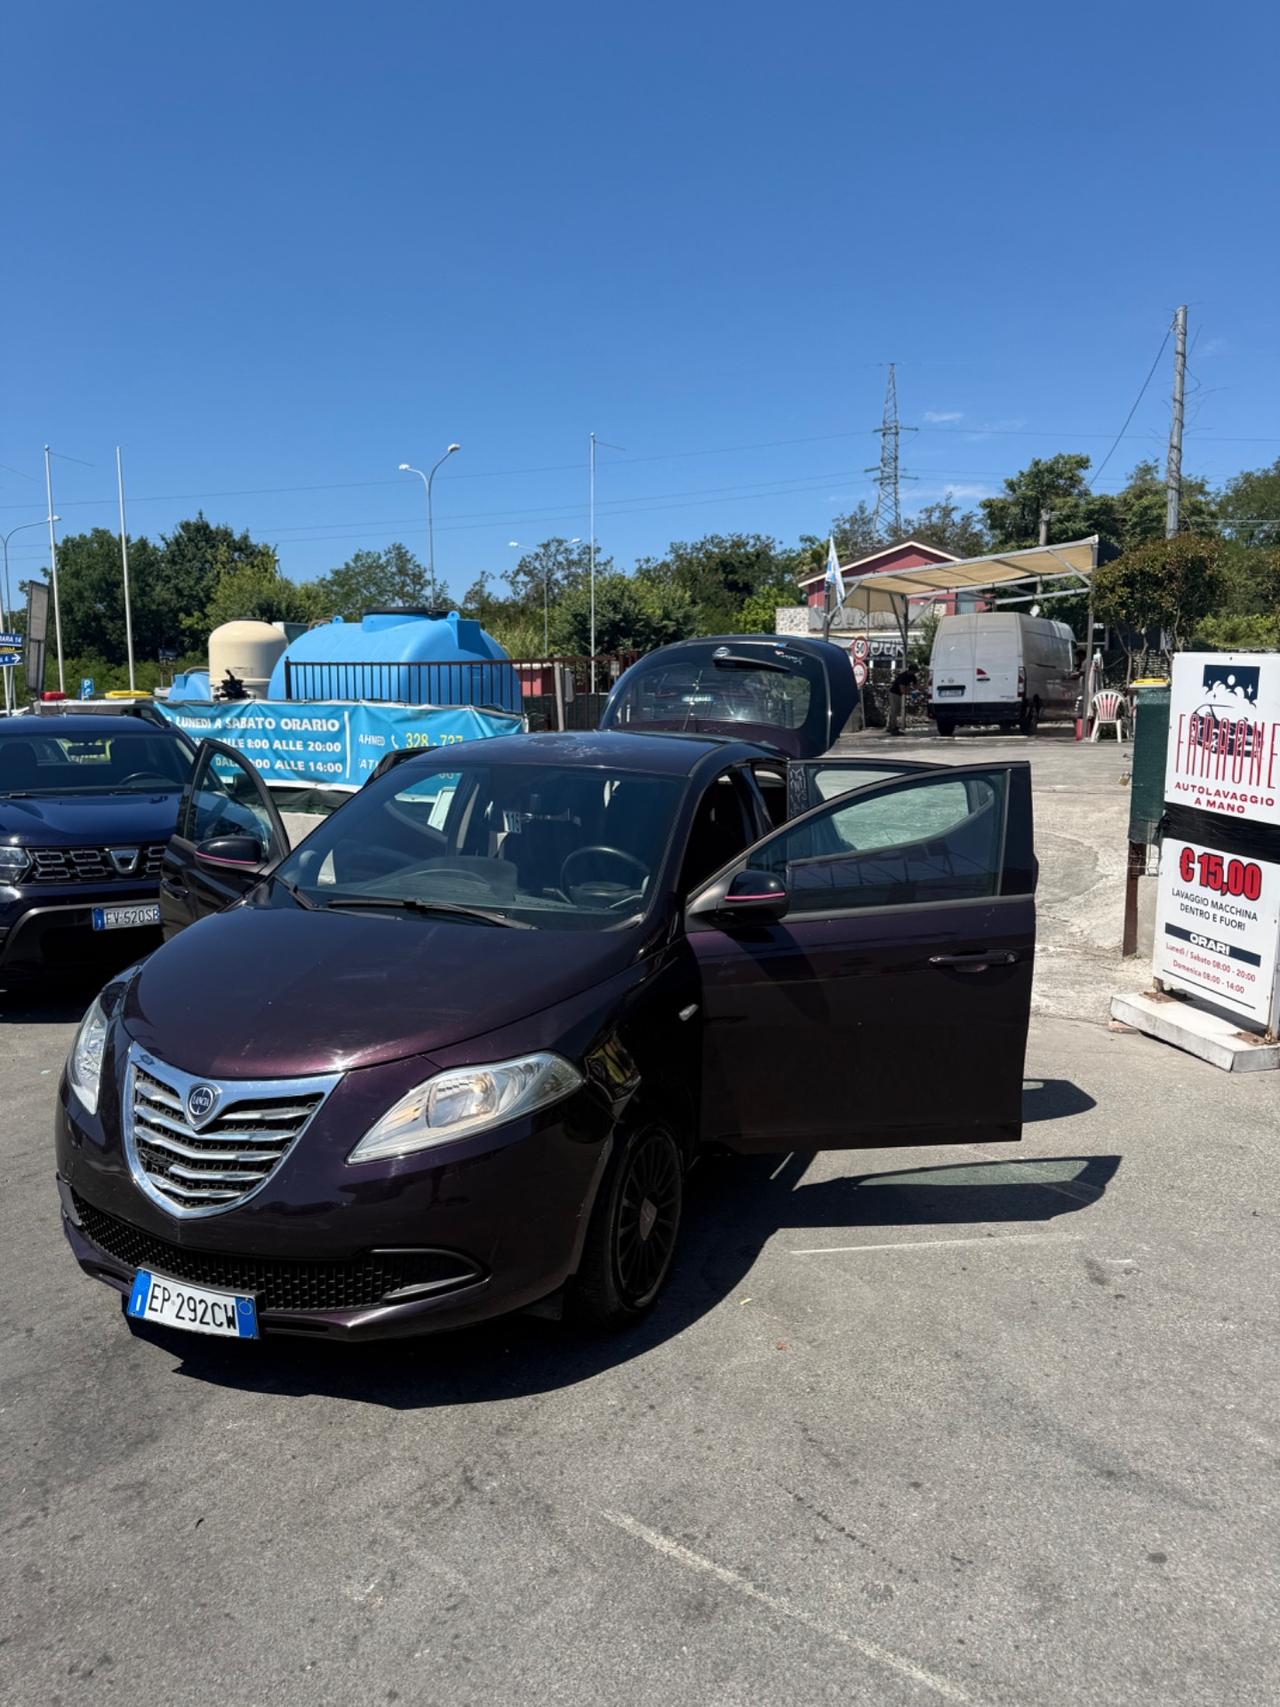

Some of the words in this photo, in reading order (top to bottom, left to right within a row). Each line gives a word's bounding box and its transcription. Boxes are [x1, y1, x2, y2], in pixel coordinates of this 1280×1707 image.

[213, 717, 222, 729] A
[225, 717, 276, 730] SABATO
[280, 718, 341, 732] ORARIO
[218, 738, 245, 749] ALLE
[272, 740, 303, 751] ALLE
[307, 741, 342, 753] 20:00
[405, 732, 429, 749] 328
[274, 762, 305, 772] ALLE
[309, 761, 343, 774] 14:00
[1174, 781, 1275, 807] AUTOLAVAGGIO
[1194, 797, 1202, 806] A
[1206, 799, 1246, 814] MANO
[1179, 846, 1196, 883] €
[1197, 851, 1263, 901] 15,00
[1171, 888, 1209, 908] LAVAGGIO
[1210, 900, 1258, 922] MACCHINA
[1179, 902, 1211, 921] DENTRO
[1212, 913, 1218, 923] E
[1219, 915, 1246, 931] FUORI
[1189, 933, 1231, 956] ORARI
[1173, 959, 1202, 977] Domenica
[1203, 971, 1221, 985] 08:00
[1226, 980, 1245, 995] 14:00
[1190, 951, 1212, 967] Sabato
[1212, 960, 1231, 974] 08:00
[1236, 968, 1256, 983] 20:00
[148, 1282, 171, 1314] EP
[175, 1292, 237, 1330] 292CW
